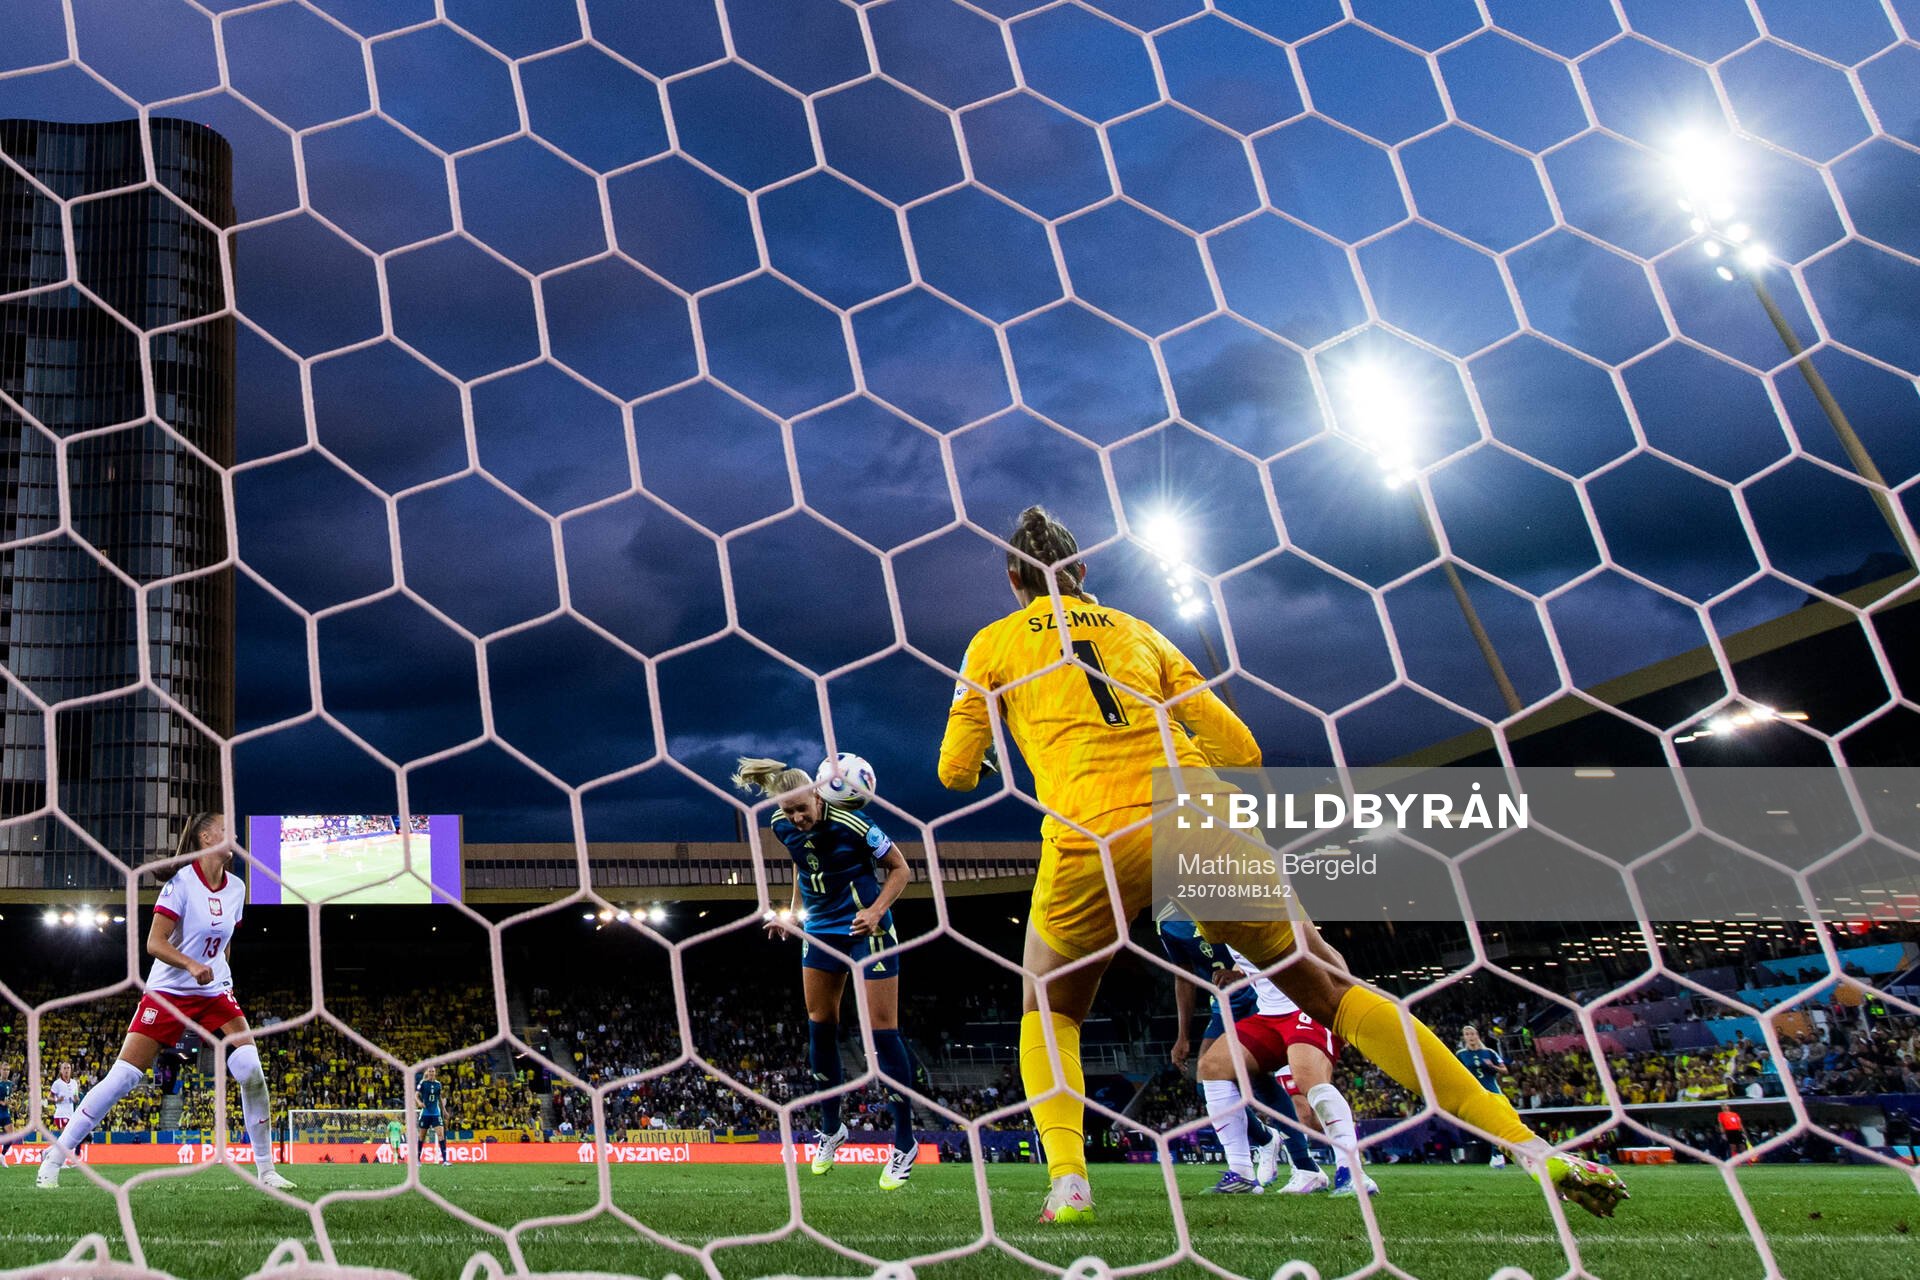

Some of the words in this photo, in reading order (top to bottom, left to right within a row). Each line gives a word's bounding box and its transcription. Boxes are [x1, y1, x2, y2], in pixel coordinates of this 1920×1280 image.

[1060, 640, 1129, 727] 1
[810, 872, 826, 894] 11
[202, 936, 221, 958] 13
